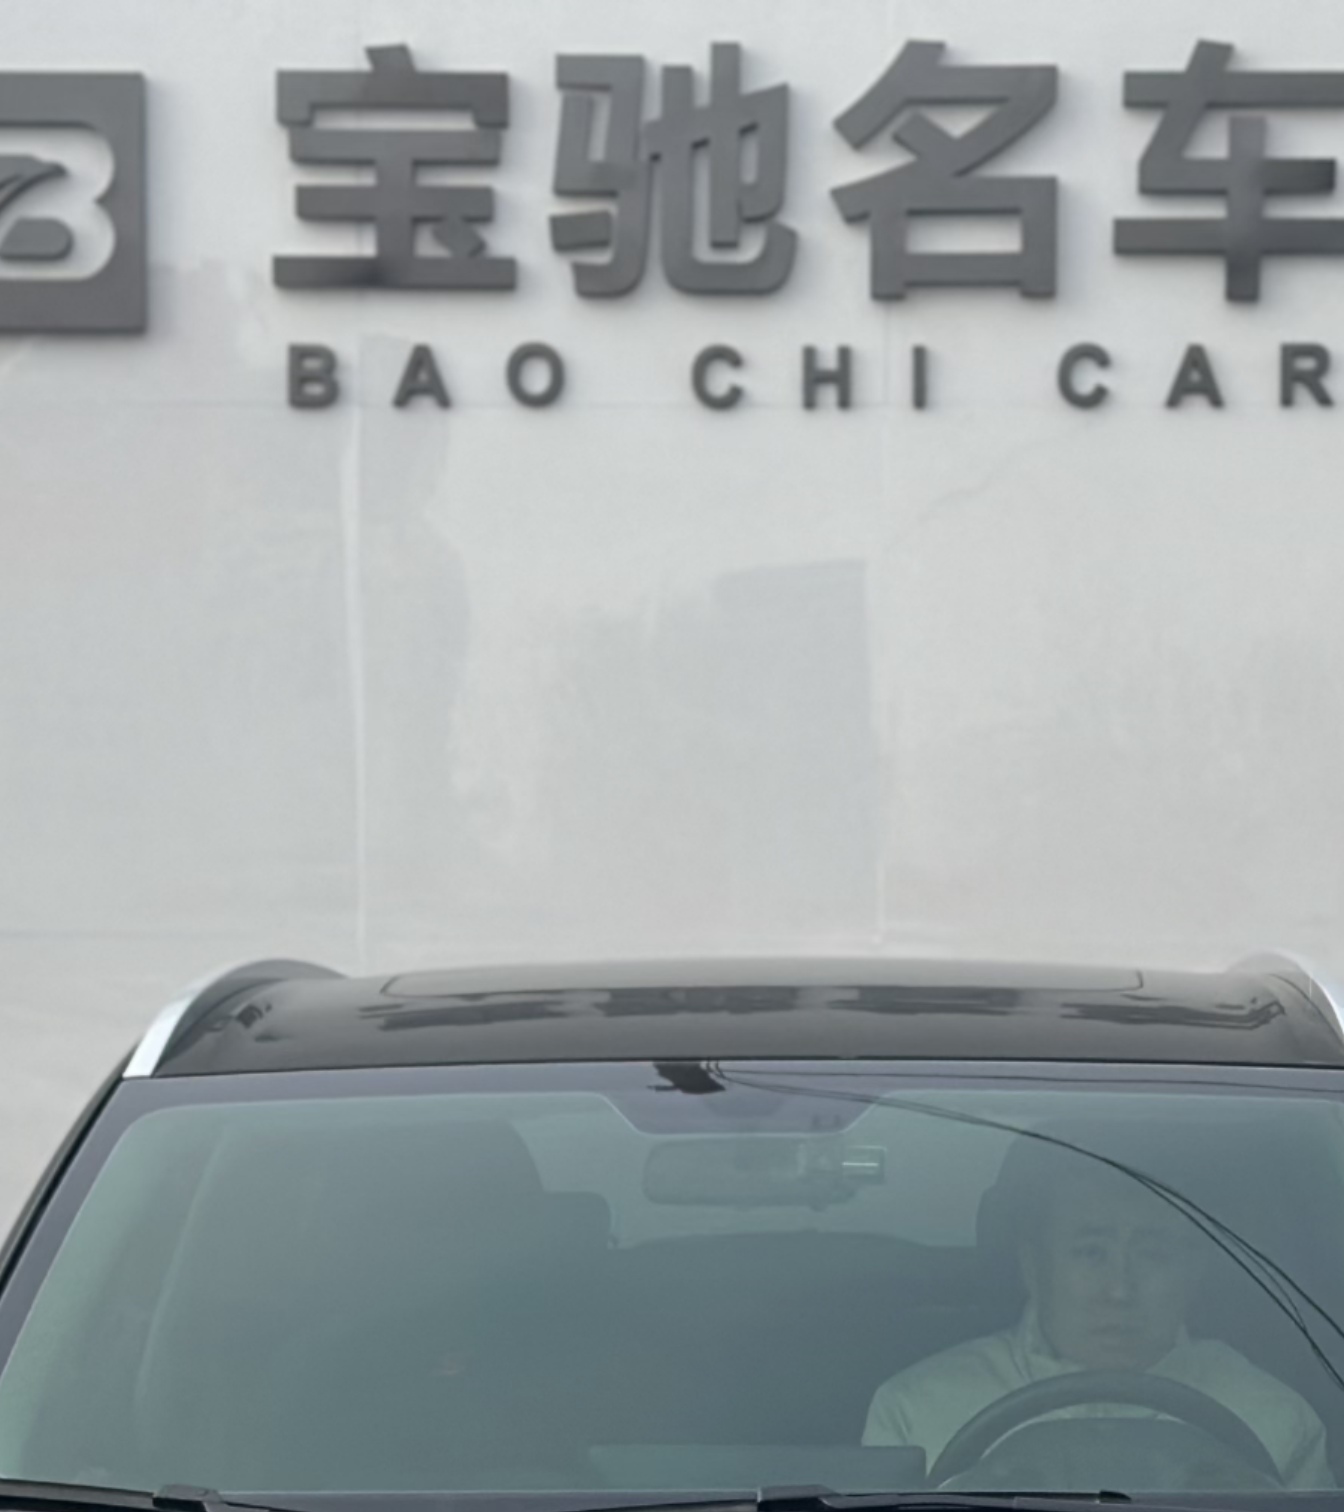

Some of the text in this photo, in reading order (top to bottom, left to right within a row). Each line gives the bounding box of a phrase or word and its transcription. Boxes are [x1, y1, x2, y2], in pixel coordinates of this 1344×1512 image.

[288, 343, 1336, 411] BAO CHI CAR
